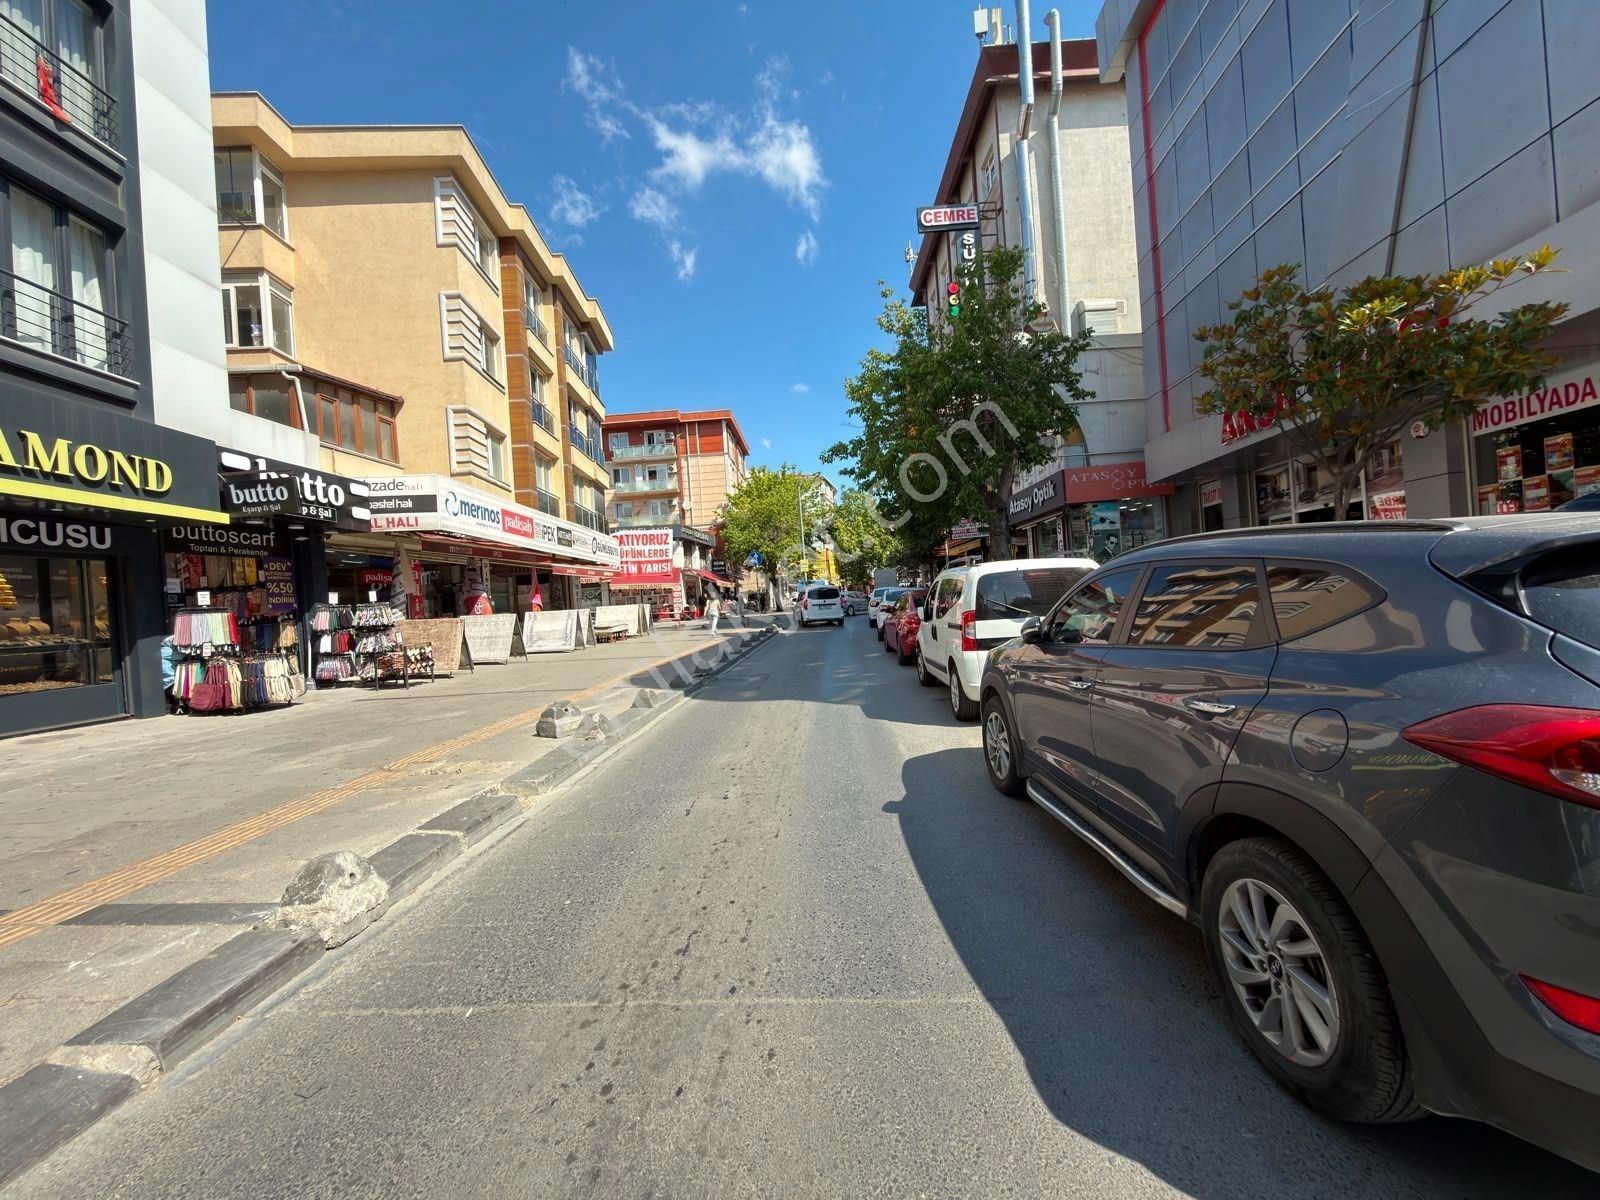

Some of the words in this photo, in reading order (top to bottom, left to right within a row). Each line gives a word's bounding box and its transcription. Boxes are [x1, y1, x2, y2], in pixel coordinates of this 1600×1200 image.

[922, 208, 977, 224] CEMRE
[1069, 468, 1137, 483] ATASOY
[229, 484, 289, 505] butto
[1009, 494, 1033, 515] Atasoy
[1033, 481, 1055, 504] Optik
[269, 503, 281, 513] Şal
[309, 507, 317, 515] &
[318, 508, 332, 519] Şal
[460, 499, 500, 525] merinos
[386, 516, 419, 527] HALI
[504, 514, 532, 536] padişah
[189, 543, 218, 553] Toptan
[228, 547, 269, 557] Perakende
[269, 562, 287, 571] DEV
[266, 582, 293, 594] %50
